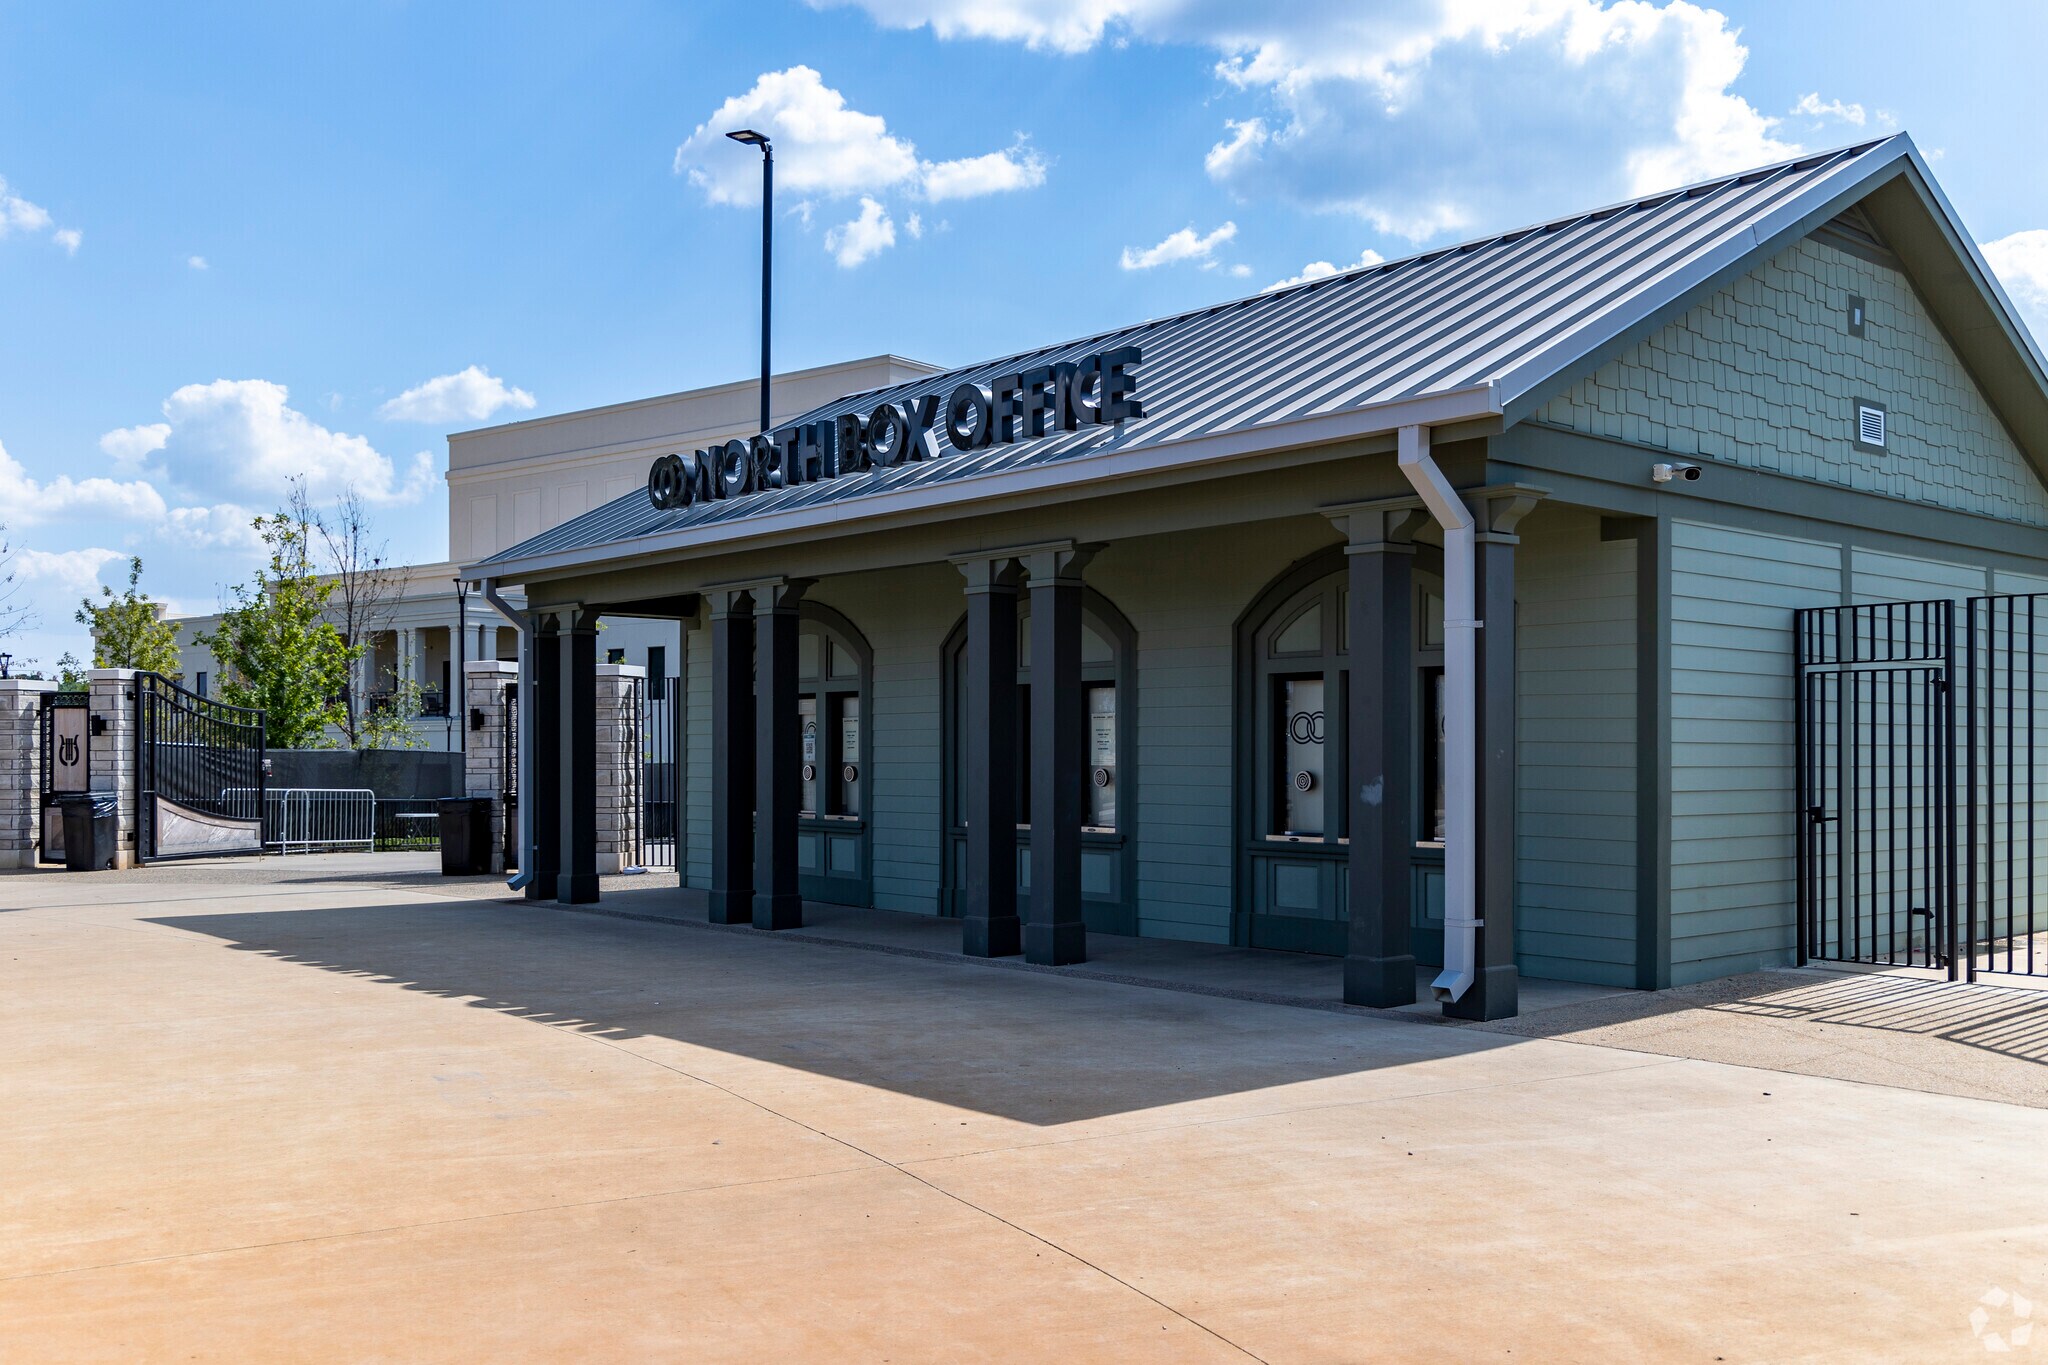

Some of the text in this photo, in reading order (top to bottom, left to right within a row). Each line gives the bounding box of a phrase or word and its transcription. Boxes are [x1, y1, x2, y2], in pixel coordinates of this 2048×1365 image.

[695, 346, 1142, 502] NORTH BOX OFFICE
